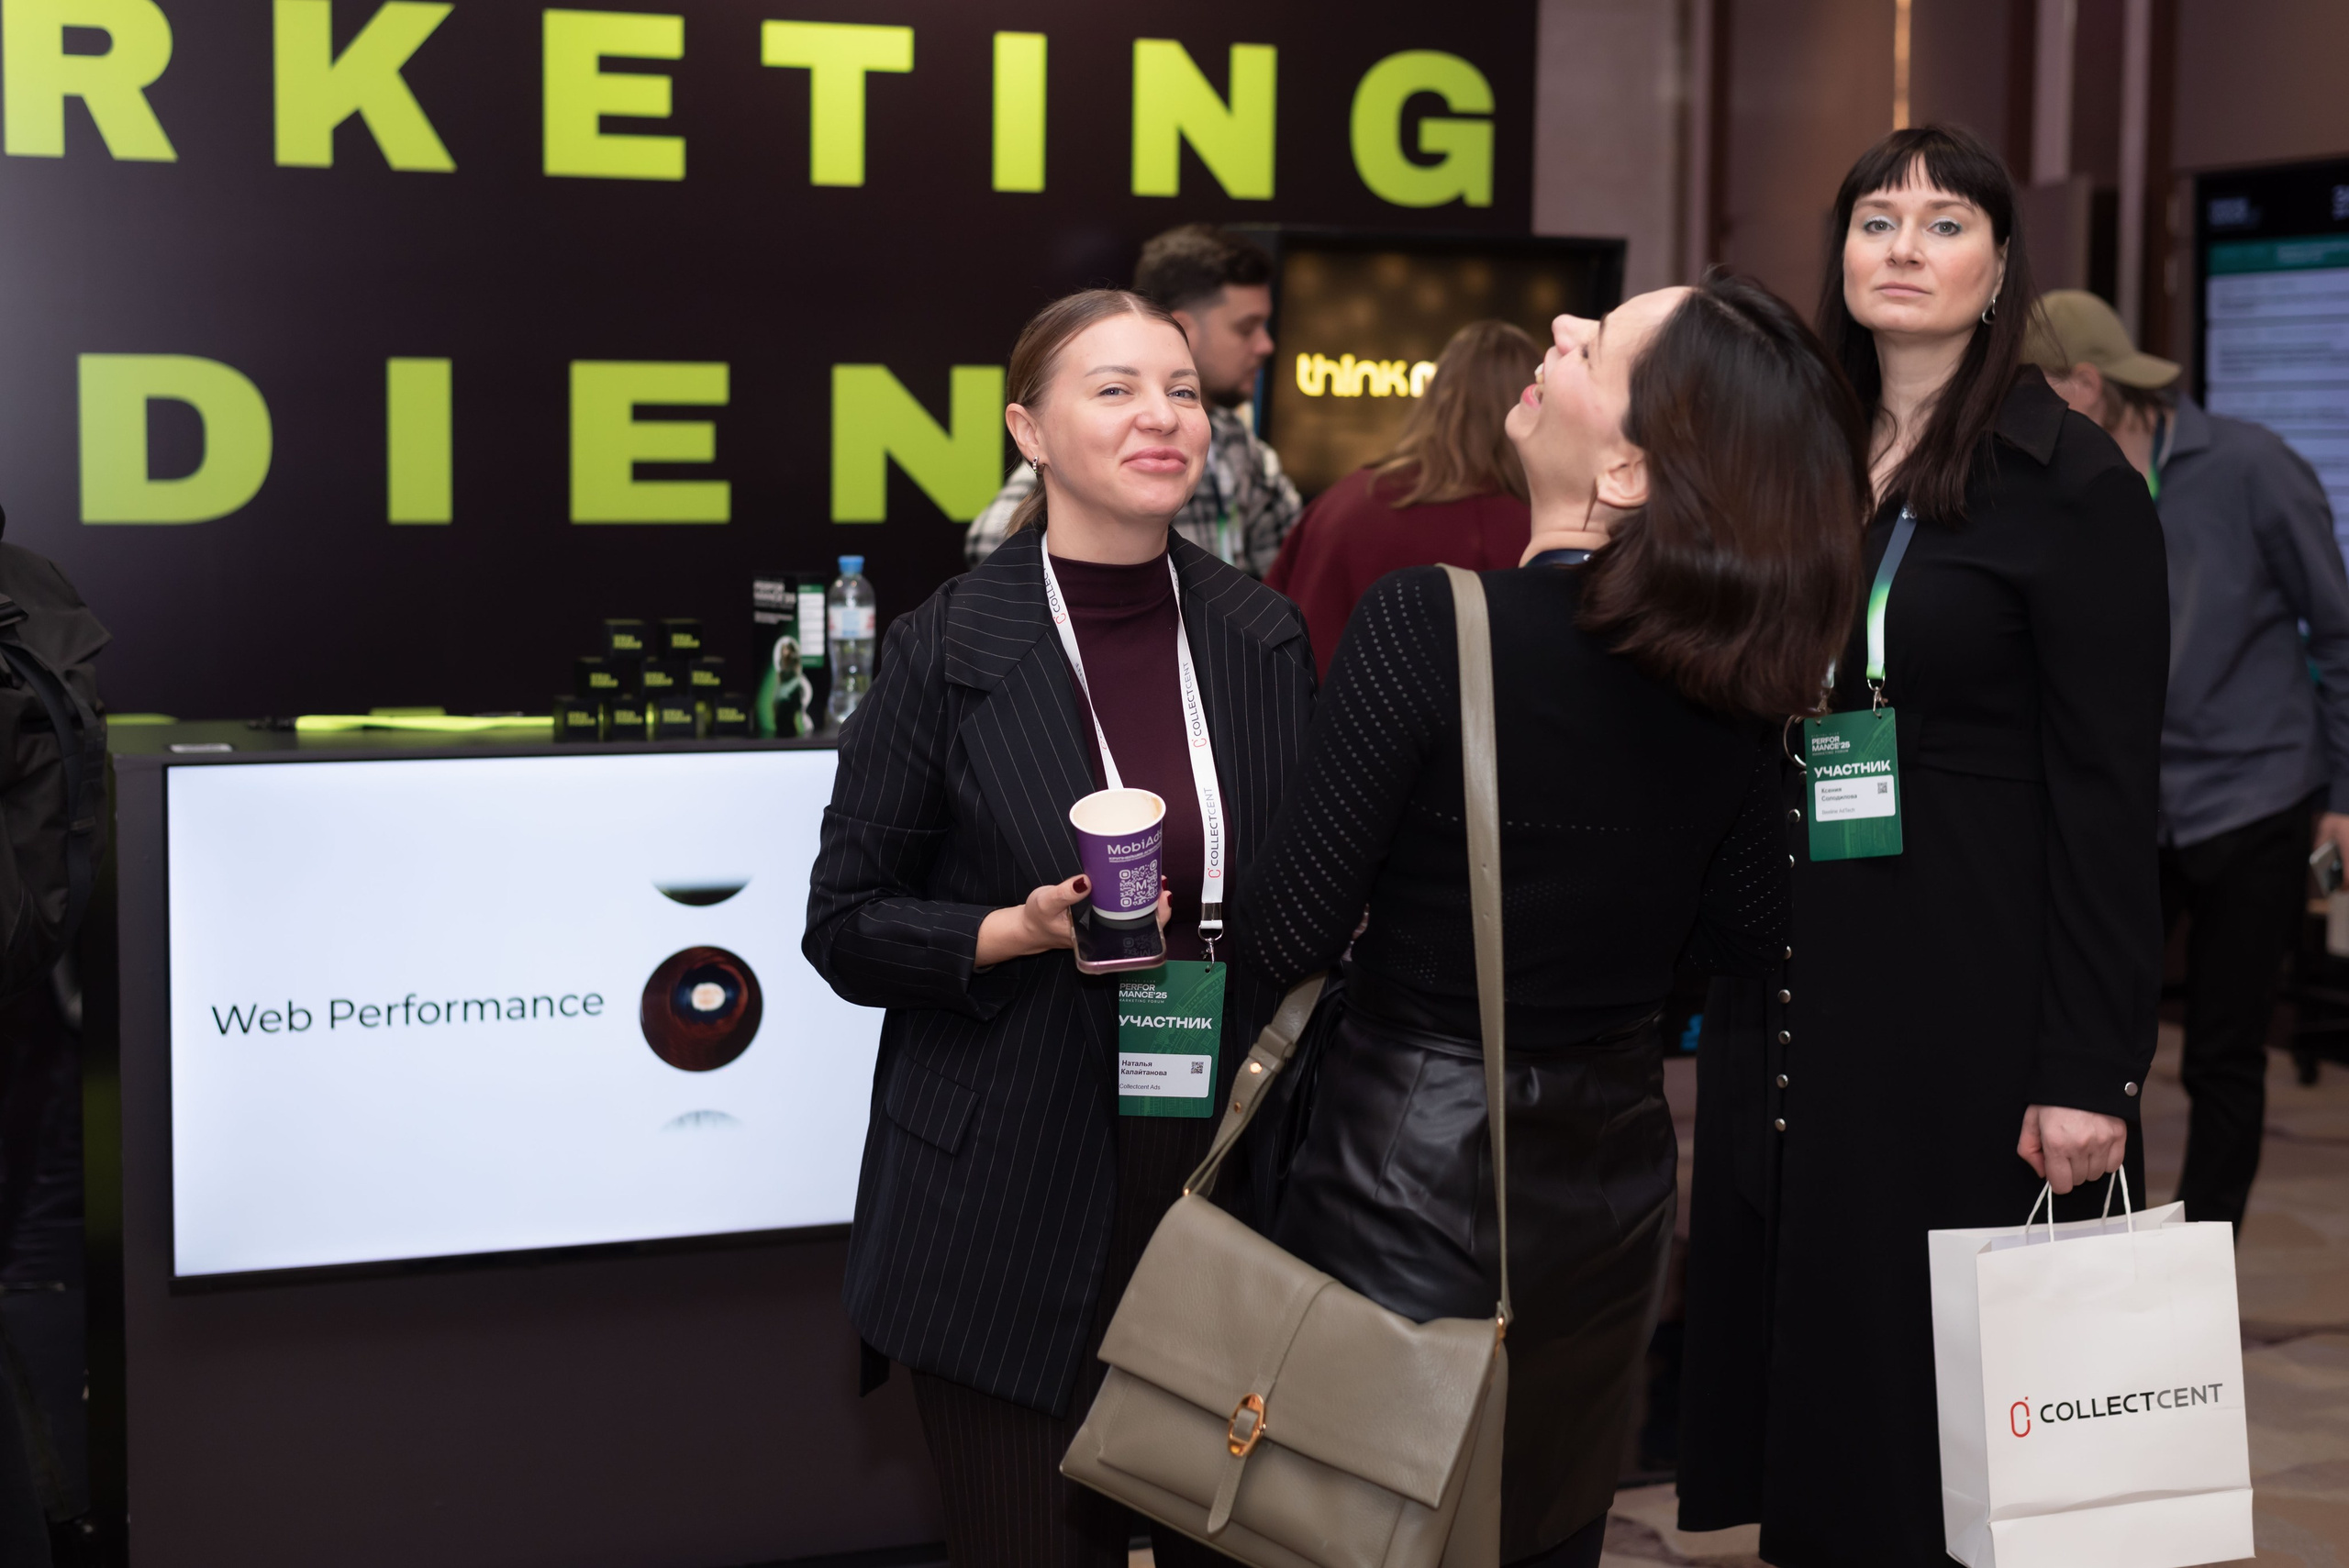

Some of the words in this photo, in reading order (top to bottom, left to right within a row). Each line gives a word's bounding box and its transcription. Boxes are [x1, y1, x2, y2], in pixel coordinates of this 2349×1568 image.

[1182, 662, 1202, 737] COLLECTCENT
[1811, 736, 1840, 744] PERFOR
[1813, 760, 1891, 778] УЧАСТНИК
[1203, 787, 1219, 867] COLLECTCENT
[1119, 983, 1155, 991] PERFOR
[1119, 991, 1167, 999] MANCE'25
[211, 1000, 313, 1036] Web
[328, 987, 606, 1031] Performance
[1119, 1015, 1213, 1029] УЧАСТНИК
[1120, 1068, 1168, 1076] Калайтанова
[2039, 1382, 2223, 1424] COLLECTCENT
